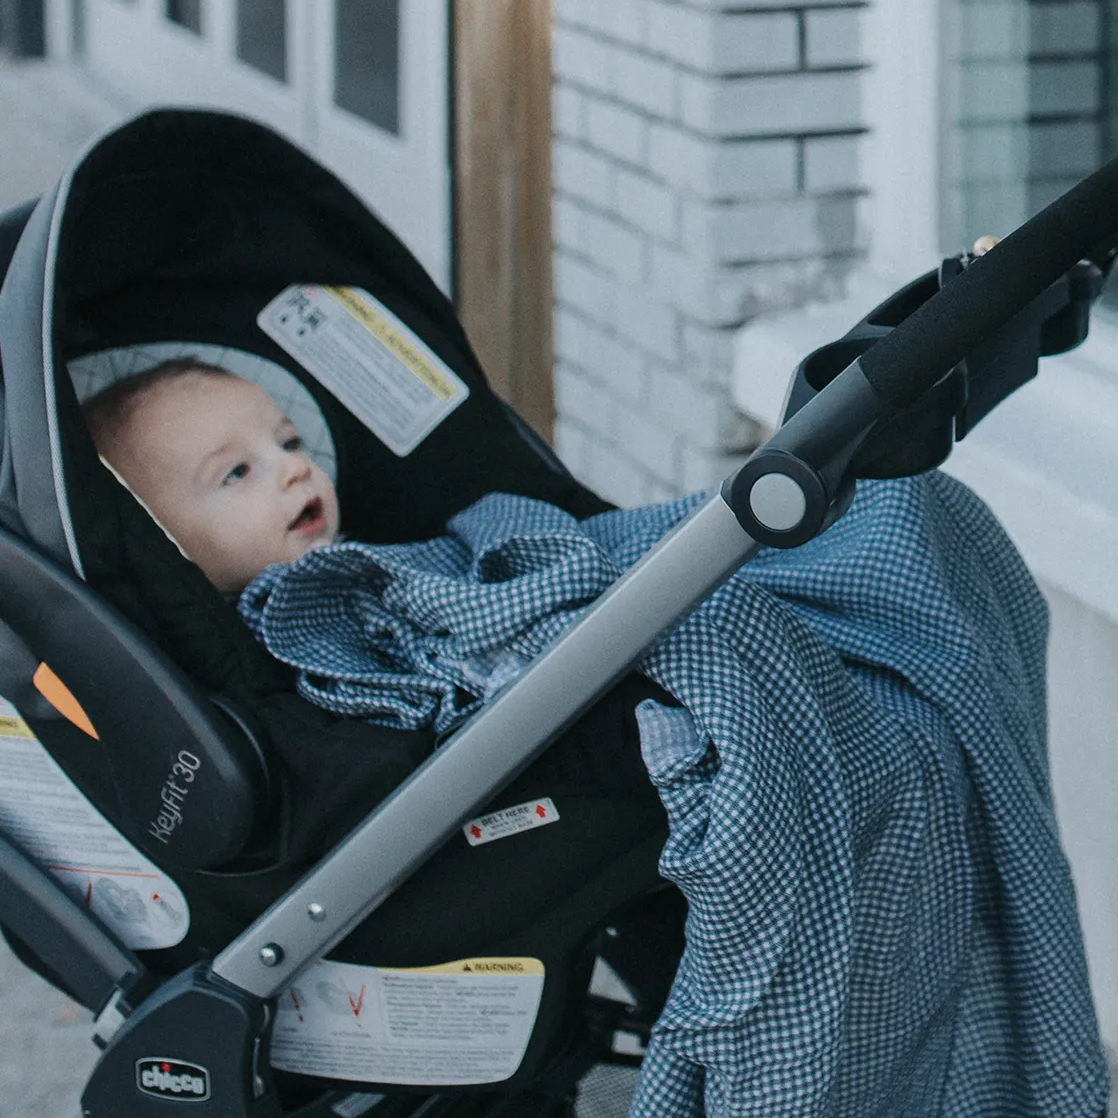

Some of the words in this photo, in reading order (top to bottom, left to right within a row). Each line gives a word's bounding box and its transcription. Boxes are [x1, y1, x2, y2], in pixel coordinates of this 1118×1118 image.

[172, 750, 201, 783] 30
[481, 813, 505, 827] BELT
[505, 806, 530, 819] HERE
[474, 962, 524, 972] WARNING
[142, 1062, 204, 1094] chicco
